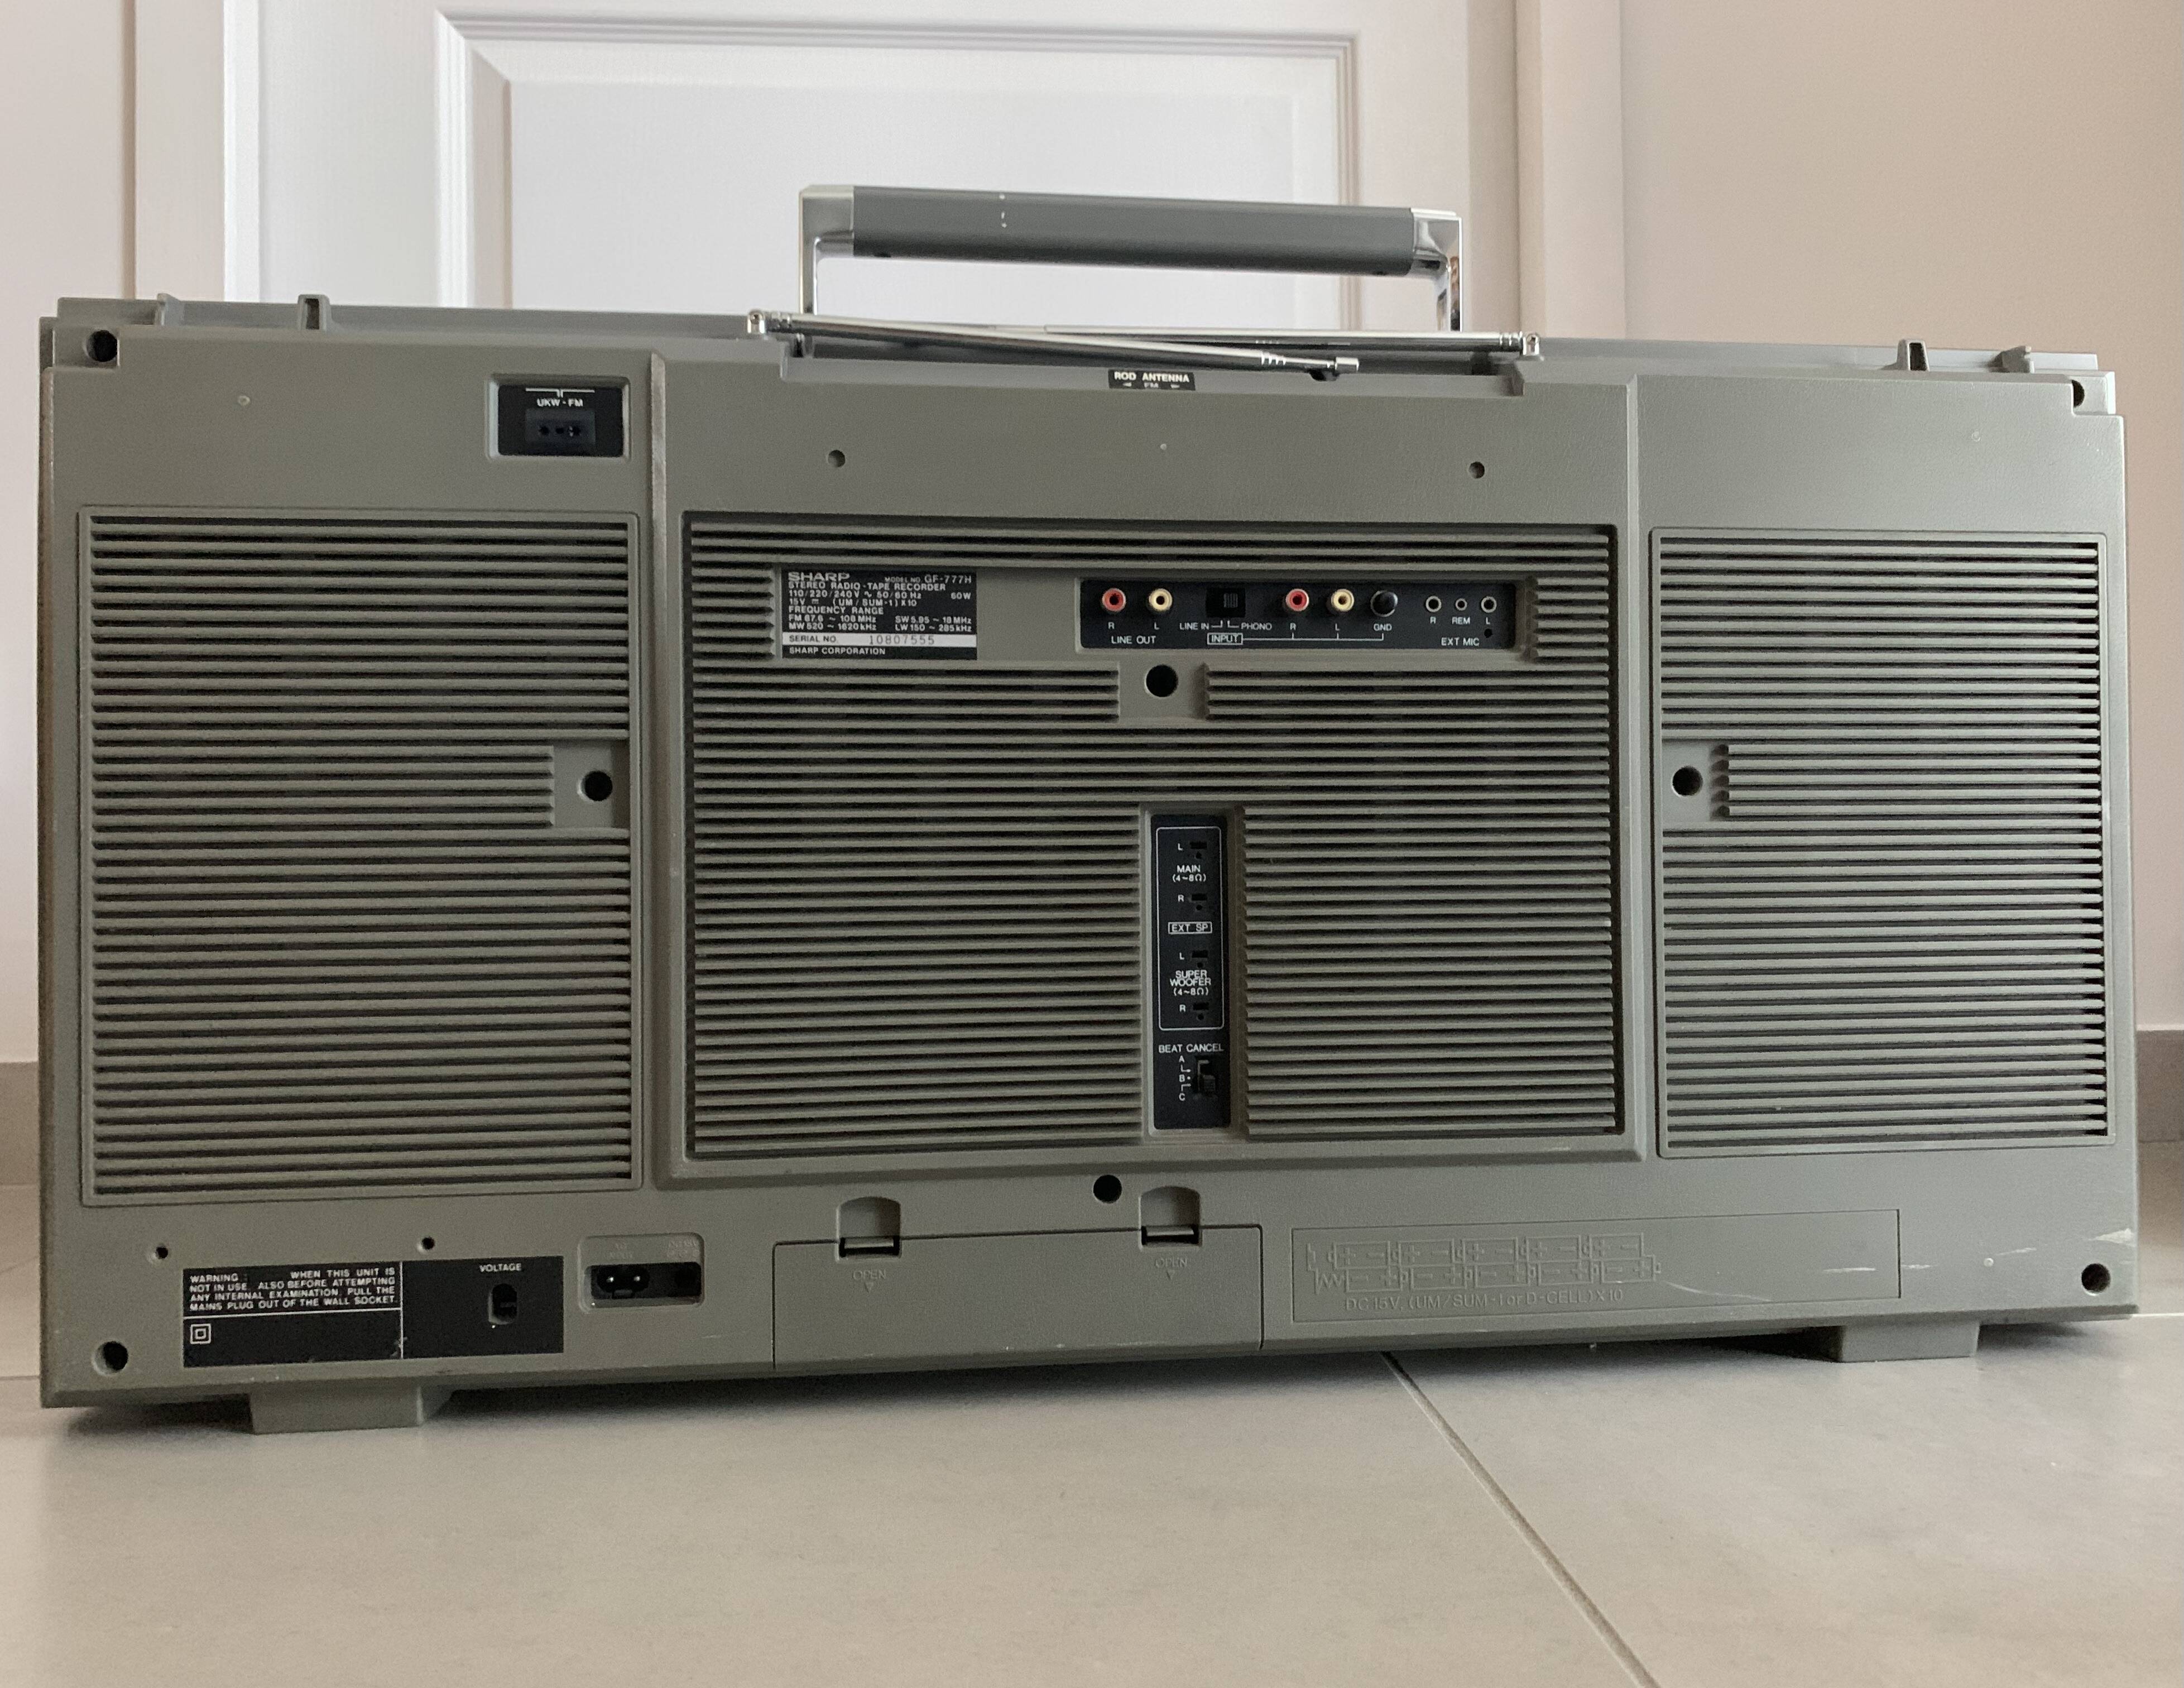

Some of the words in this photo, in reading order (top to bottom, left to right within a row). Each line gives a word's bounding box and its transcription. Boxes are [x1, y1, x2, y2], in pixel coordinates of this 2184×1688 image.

[1113, 371, 1136, 380] ROD
[1142, 372, 1190, 382] ANTENNA
[788, 572, 850, 581] SHARP
[924, 574, 972, 584] GF-777H
[894, 583, 946, 591] RECORDER
[789, 606, 846, 614] FREQUENCY
[789, 634, 820, 642] SERIAL
[869, 634, 935, 645] 10807555
[1111, 635, 1132, 644] LINE
[1136, 635, 1156, 644] OUT
[1211, 634, 1239, 643] INPUT
[1441, 637, 1459, 646] EXT
[1463, 637, 1480, 646] MIC
[1177, 865, 1201, 873] MAIN
[1172, 924, 1190, 932] EXT
[1175, 970, 1207, 979] SUPER
[1170, 978, 1211, 987] WOOFER
[1179, 1004, 1186, 1013] R
[1158, 1044, 1183, 1053] BEAT
[1186, 1043, 1224, 1053] CANCEL
[1179, 1093, 1185, 1101] C
[1155, 1257, 1187, 1268] OPEN
[479, 1263, 522, 1273] VOLTAGE
[290, 1270, 320, 1279] WHEN
[326, 1269, 350, 1277] THIS
[356, 1268, 379, 1276] UNIT
[385, 1267, 395, 1275] IS
[852, 1269, 886, 1280] OPEN
[189, 1284, 210, 1293] NOT
[258, 1281, 285, 1289] ALSO
[287, 1279, 327, 1288] BEFORE
[333, 1277, 395, 1286] ATTEMPTING
[214, 1292, 263, 1300] INTERNAL
[347, 1287, 372, 1296] PULL
[376, 1286, 395, 1294] THE
[190, 1302, 223, 1311] MAINS
[227, 1301, 254, 1310] PLUG
[258, 1300, 279, 1308] OUT
[282, 1299, 296, 1308] OF
[300, 1298, 319, 1306] THE
[1346, 1297, 1369, 1311] DC
